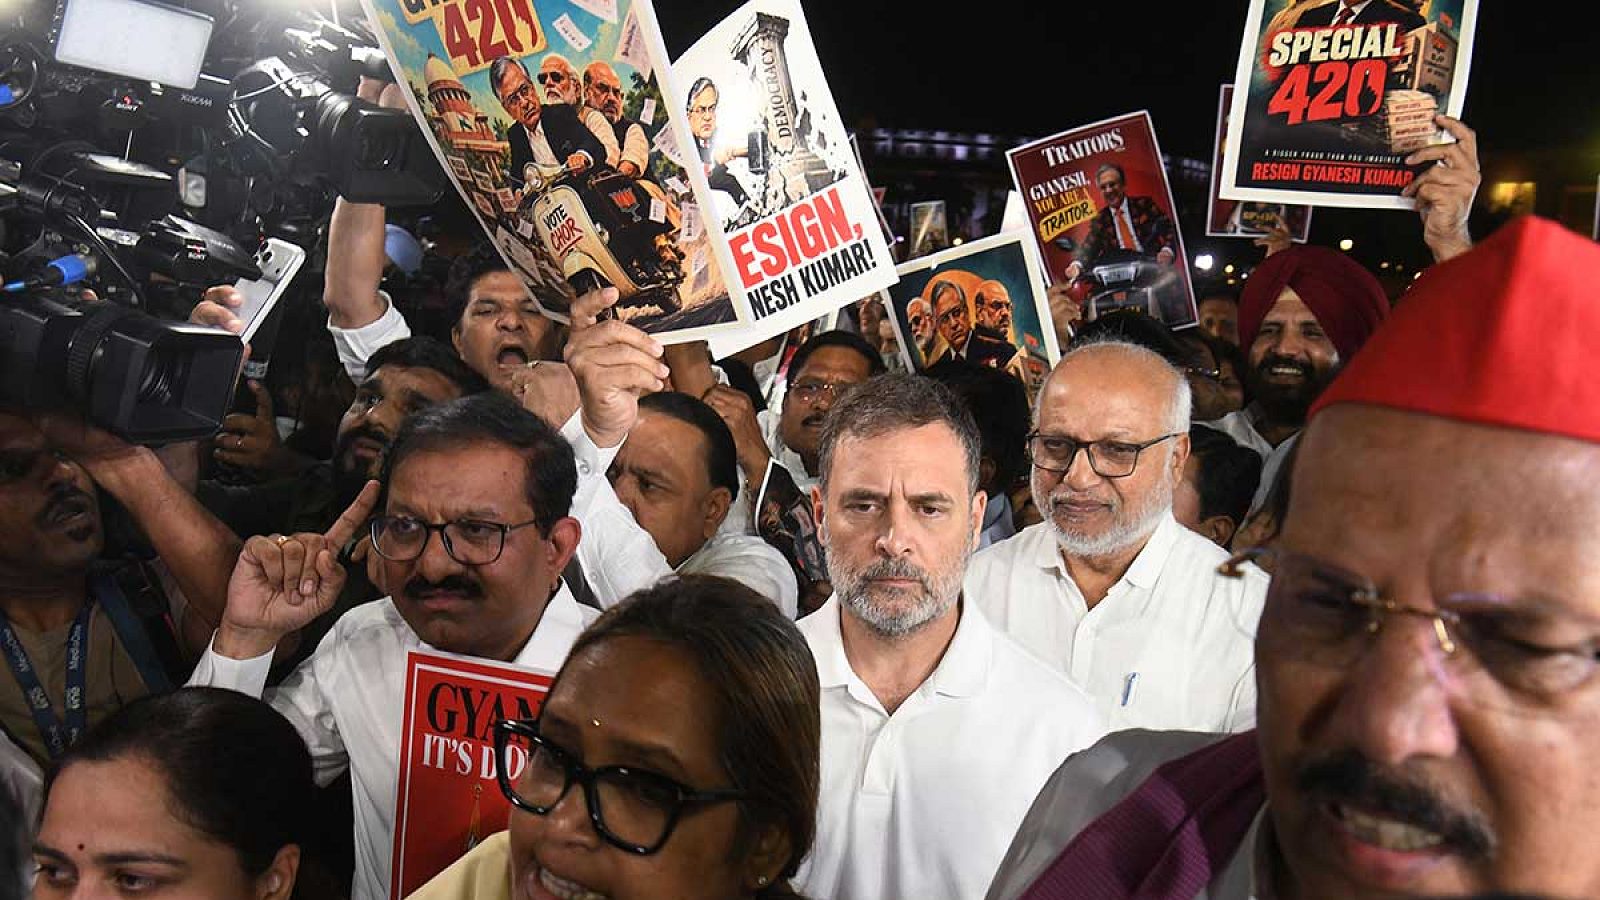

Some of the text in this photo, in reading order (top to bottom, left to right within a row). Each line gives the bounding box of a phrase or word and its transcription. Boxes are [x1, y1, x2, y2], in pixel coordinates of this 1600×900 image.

[444, 0, 538, 68] 420
[1269, 24, 1402, 67] SPECIAL
[761, 47, 792, 138] DEMOCRACY
[1268, 60, 1387, 125] 420
[1041, 128, 1124, 168] TRAITORS
[1251, 163, 1414, 187] RESIGN GYANESH KUMAR
[543, 204, 567, 230] VOTE
[551, 217, 583, 251] CHOR
[728, 188, 864, 289] ESIGN,
[1043, 202, 1093, 236] TRAITOR.
[747, 238, 877, 320] NESH KUMAR!
[423, 733, 529, 780] IT'S DO
